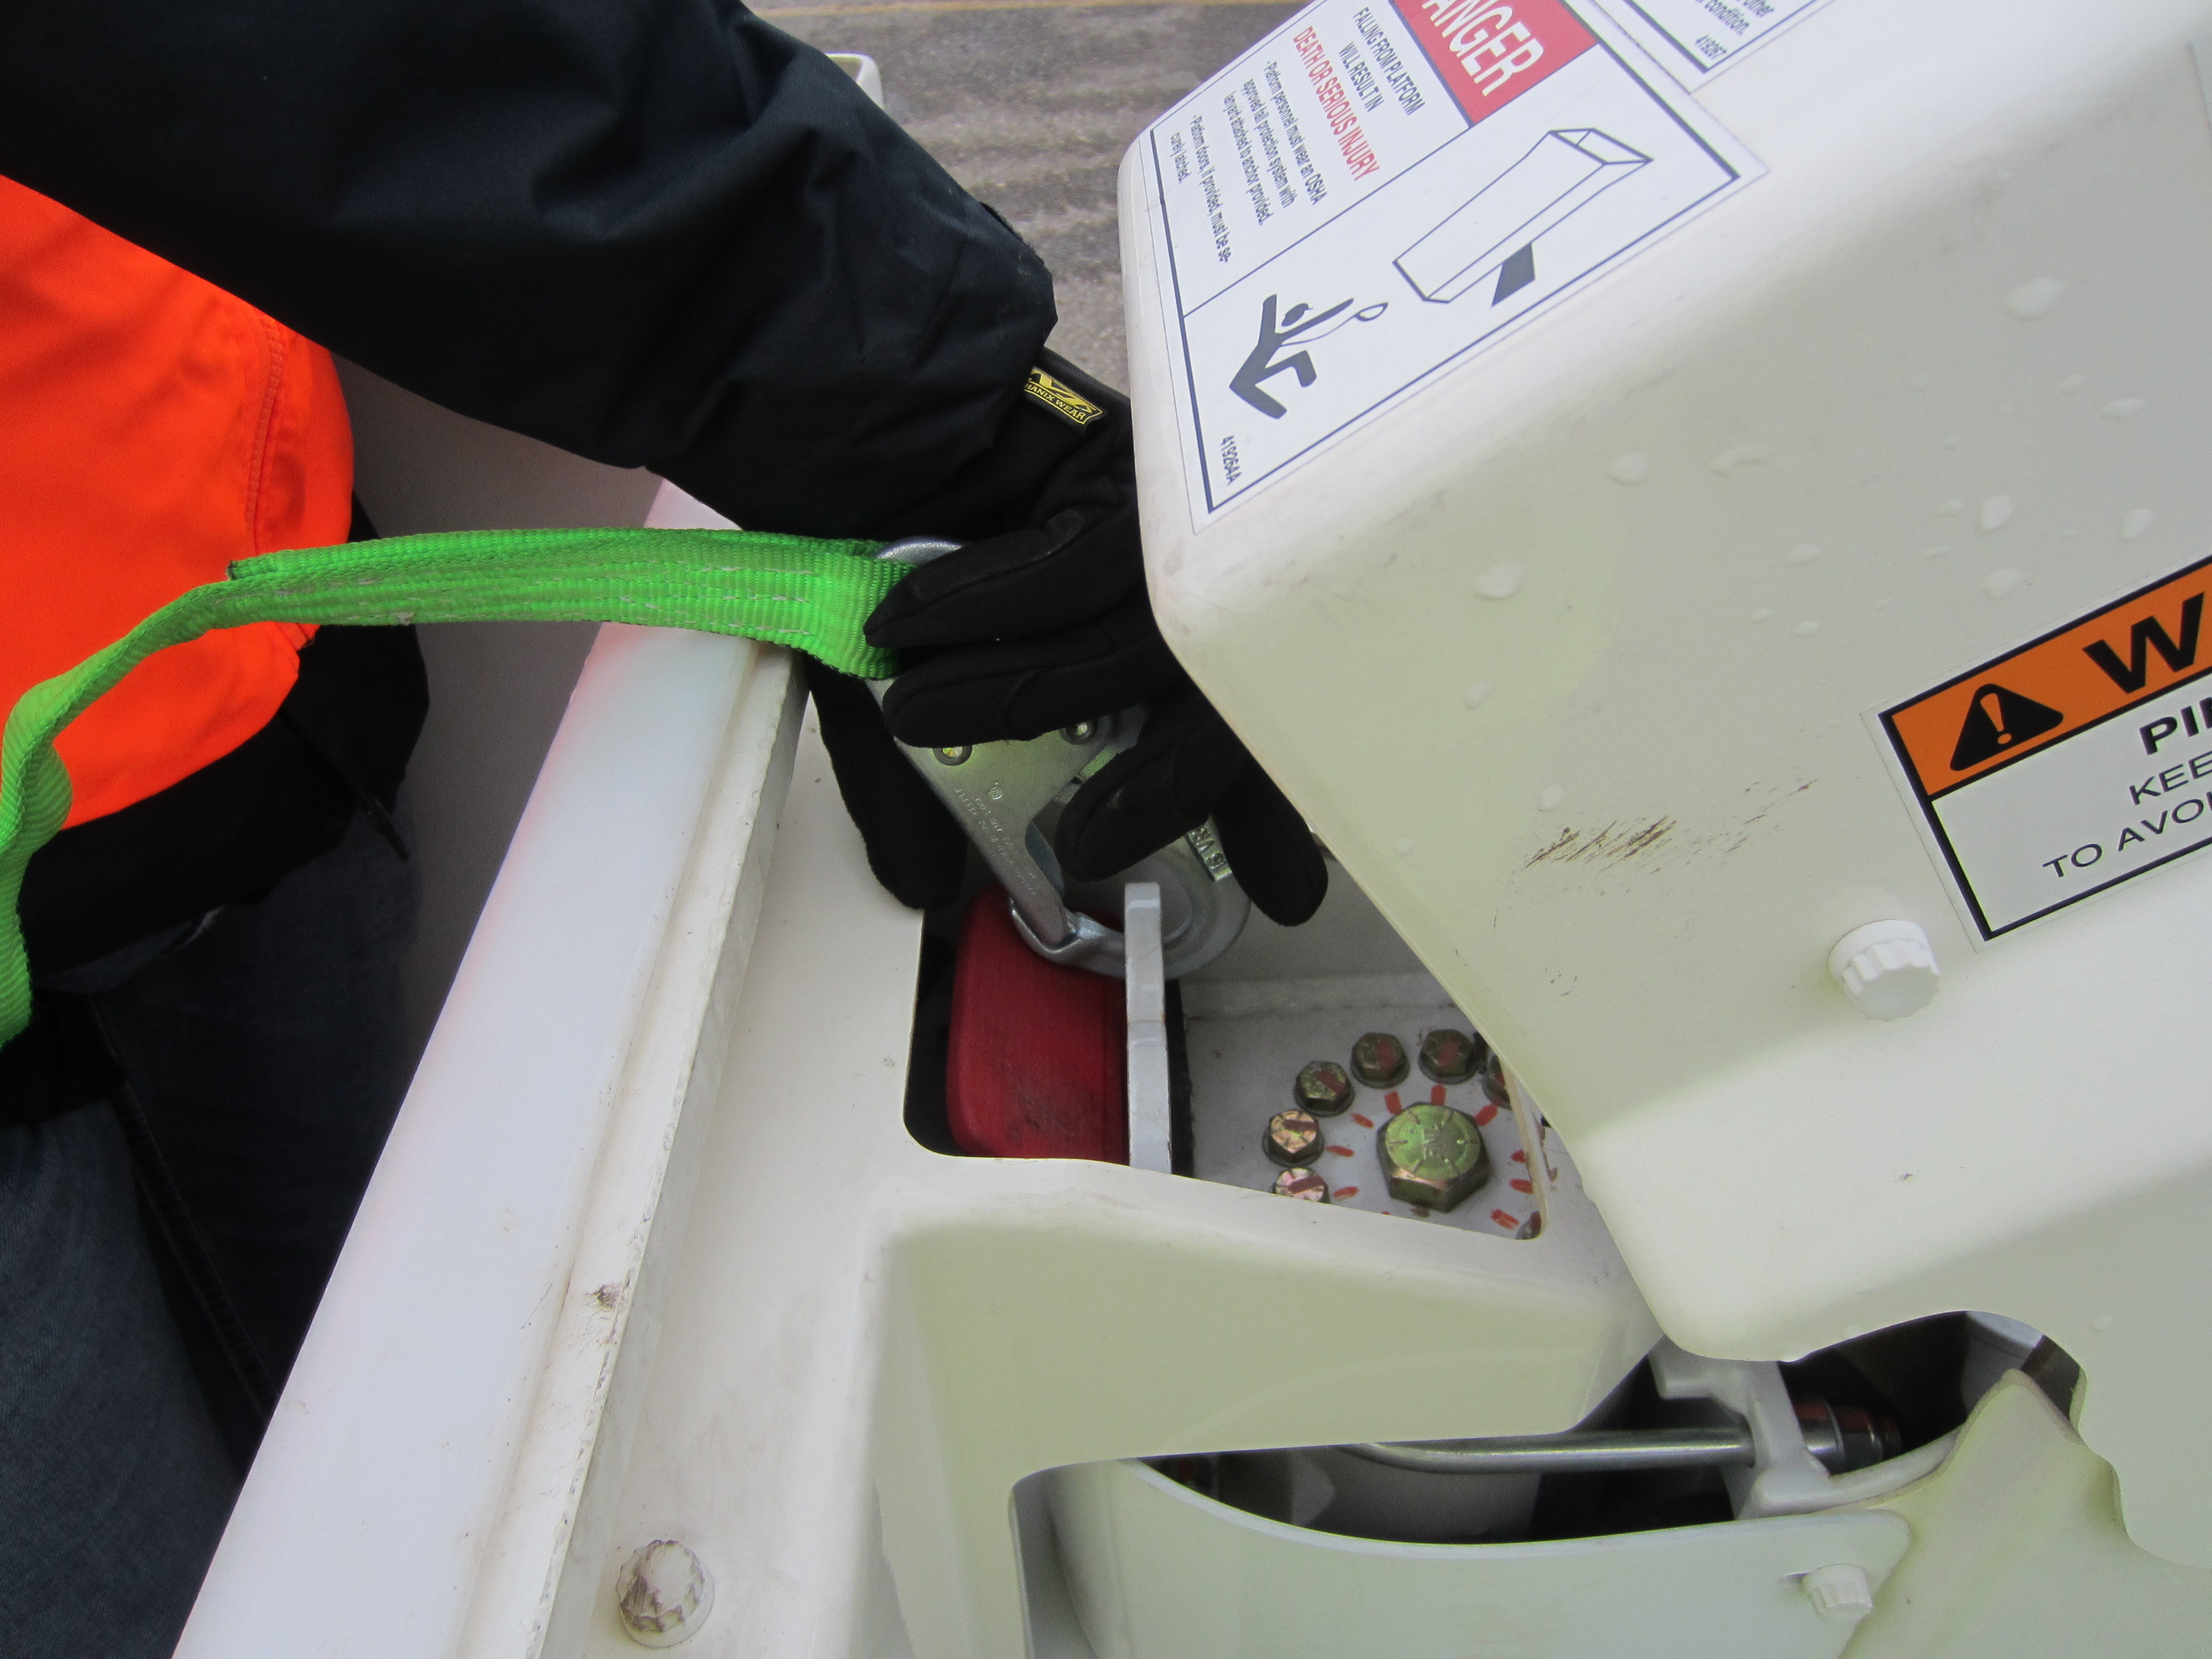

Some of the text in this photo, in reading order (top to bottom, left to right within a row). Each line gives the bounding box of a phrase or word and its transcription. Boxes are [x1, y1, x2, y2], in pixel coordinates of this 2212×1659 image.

[1705, 0, 1749, 35] condition.
[1353, 7, 1426, 116] FALLING FROM PLATFORM
[1695, 35, 1726, 59] 419267
[1338, 41, 1385, 113] WILL RESULT IN
[1269, 90, 1299, 128] personnel
[1292, 25, 1380, 182] DEATH OR SERIOUS INJURY
[1170, 132, 1185, 157] curely
[1241, 78, 1298, 208] approved fall protection system with
[1286, 124, 1305, 148] must
[1196, 145, 1210, 174] doors,
[1223, 90, 1274, 226] lanyard attached to anchor provided.
[1293, 143, 1310, 166] wear
[1300, 164, 1314, 179] an
[1305, 173, 1328, 206] OSHA
[1211, 211, 1228, 238] must
[1215, 231, 1230, 249] be
[1056, 399, 1086, 420] WEAR
[2083, 592, 2205, 695] W
[2042, 843, 2103, 878] TO
